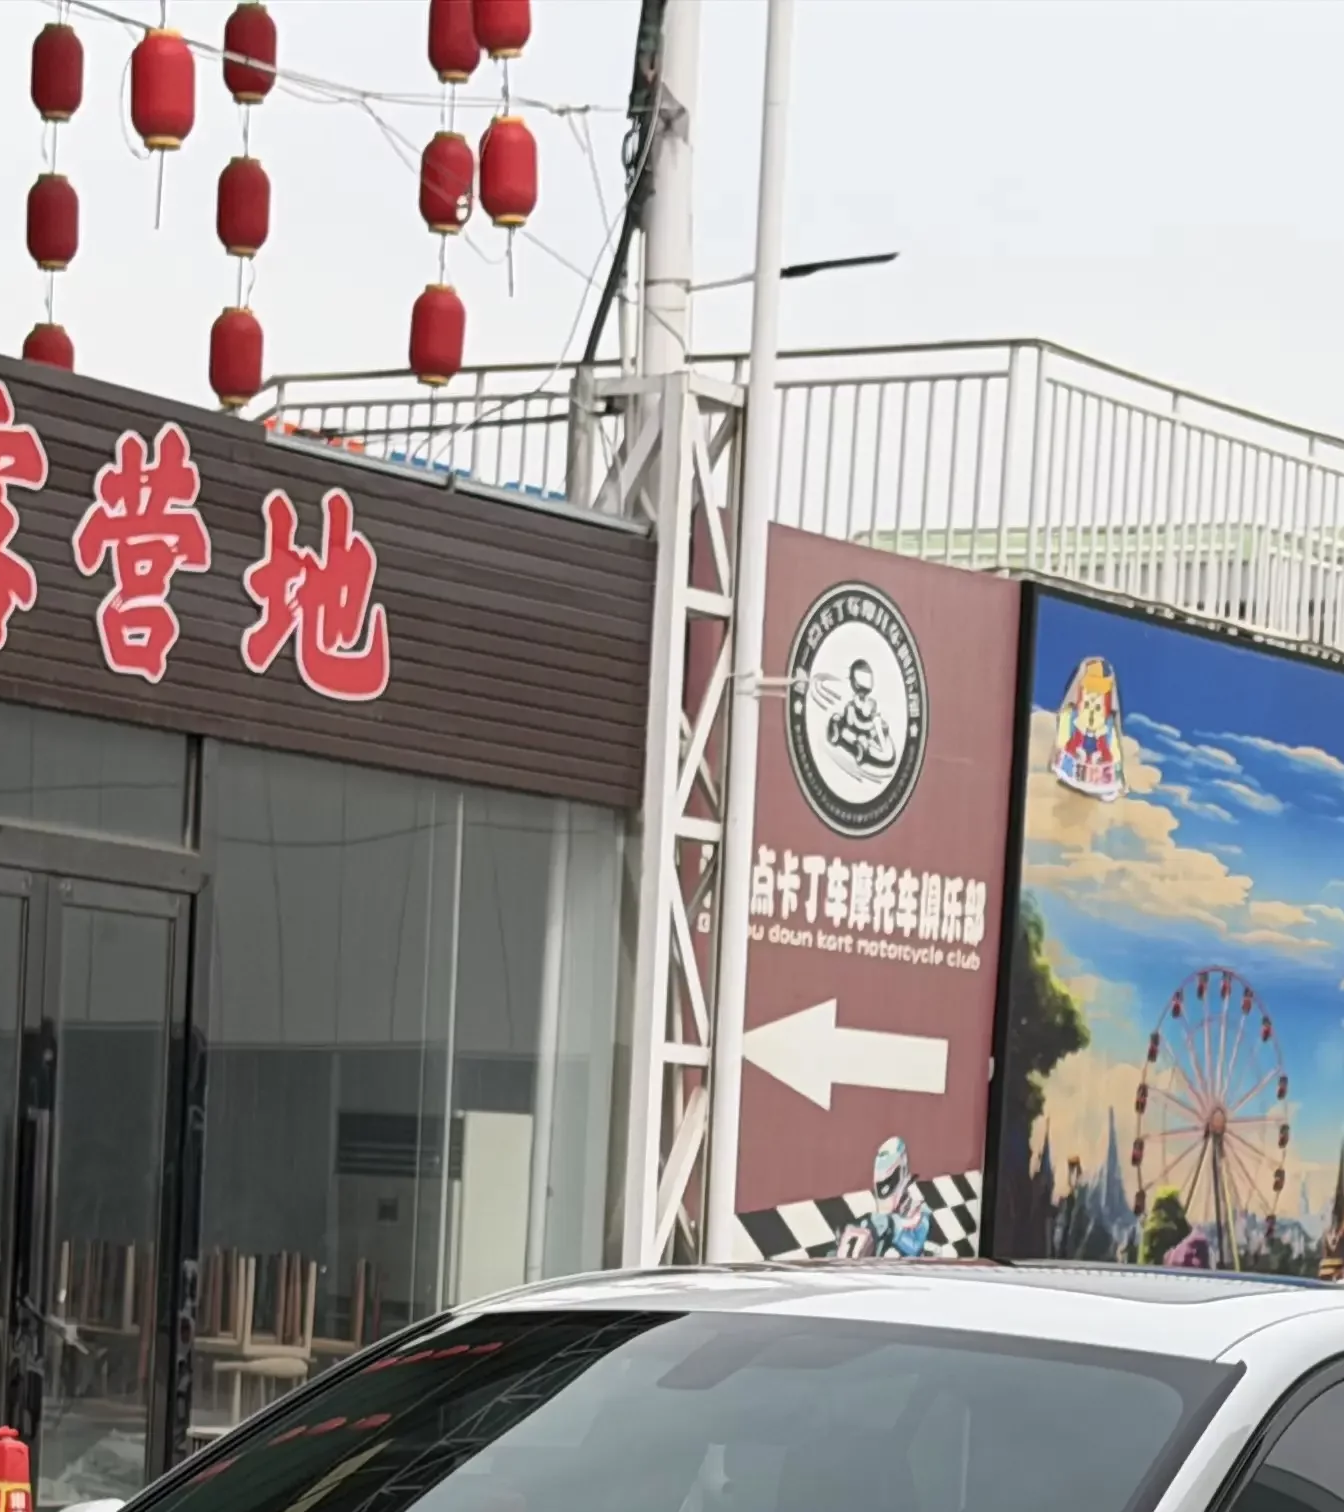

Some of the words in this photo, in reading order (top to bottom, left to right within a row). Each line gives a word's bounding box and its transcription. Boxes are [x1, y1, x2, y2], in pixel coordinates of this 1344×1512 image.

[768, 923, 813, 948] down
[816, 928, 853, 954] kart
[946, 948, 981, 972] club
